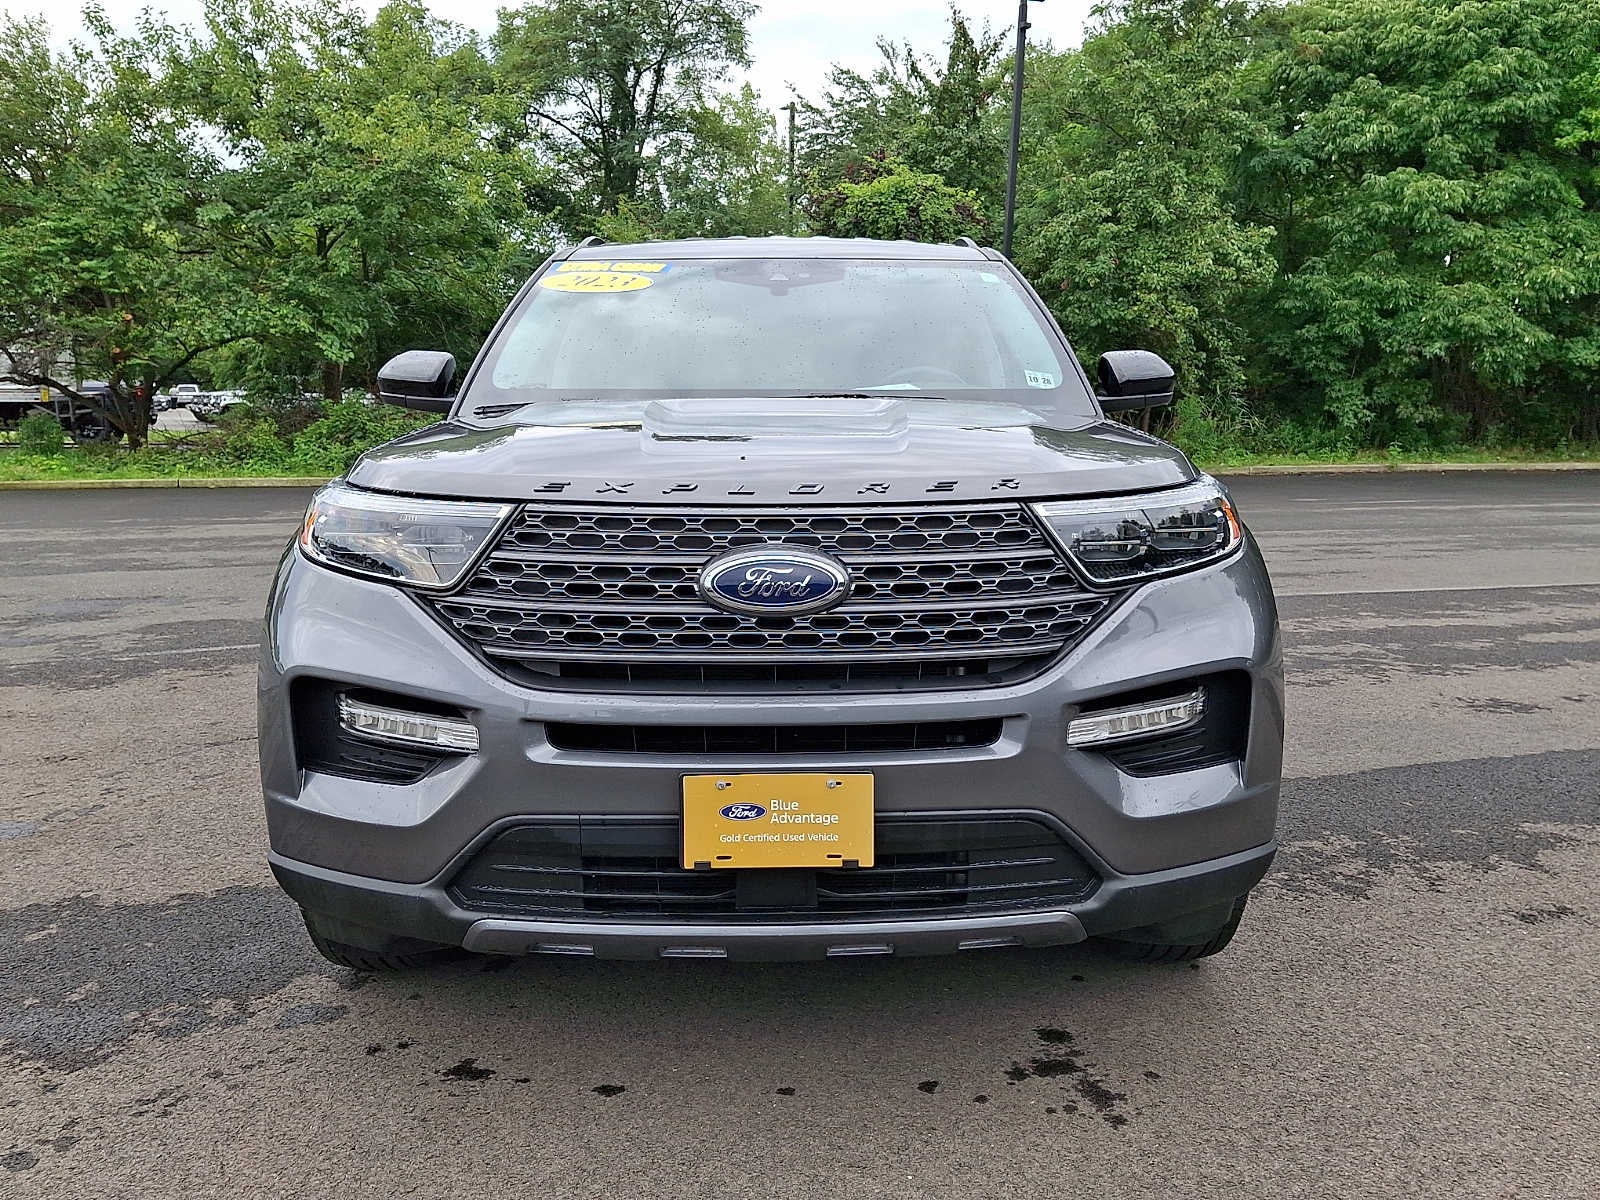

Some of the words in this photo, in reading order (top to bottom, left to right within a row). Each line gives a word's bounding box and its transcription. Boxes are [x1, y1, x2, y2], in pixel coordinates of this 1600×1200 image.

[533, 478, 1021, 496] EXPLORER
[738, 567, 812, 598] Ford
[728, 805, 758, 818] Ford
[770, 799, 799, 811] Blue
[770, 812, 839, 826] Advantage
[720, 833, 741, 843] Gold
[743, 833, 780, 842] Certified
[782, 833, 805, 842] Used
[807, 832, 839, 842] Vehicle
